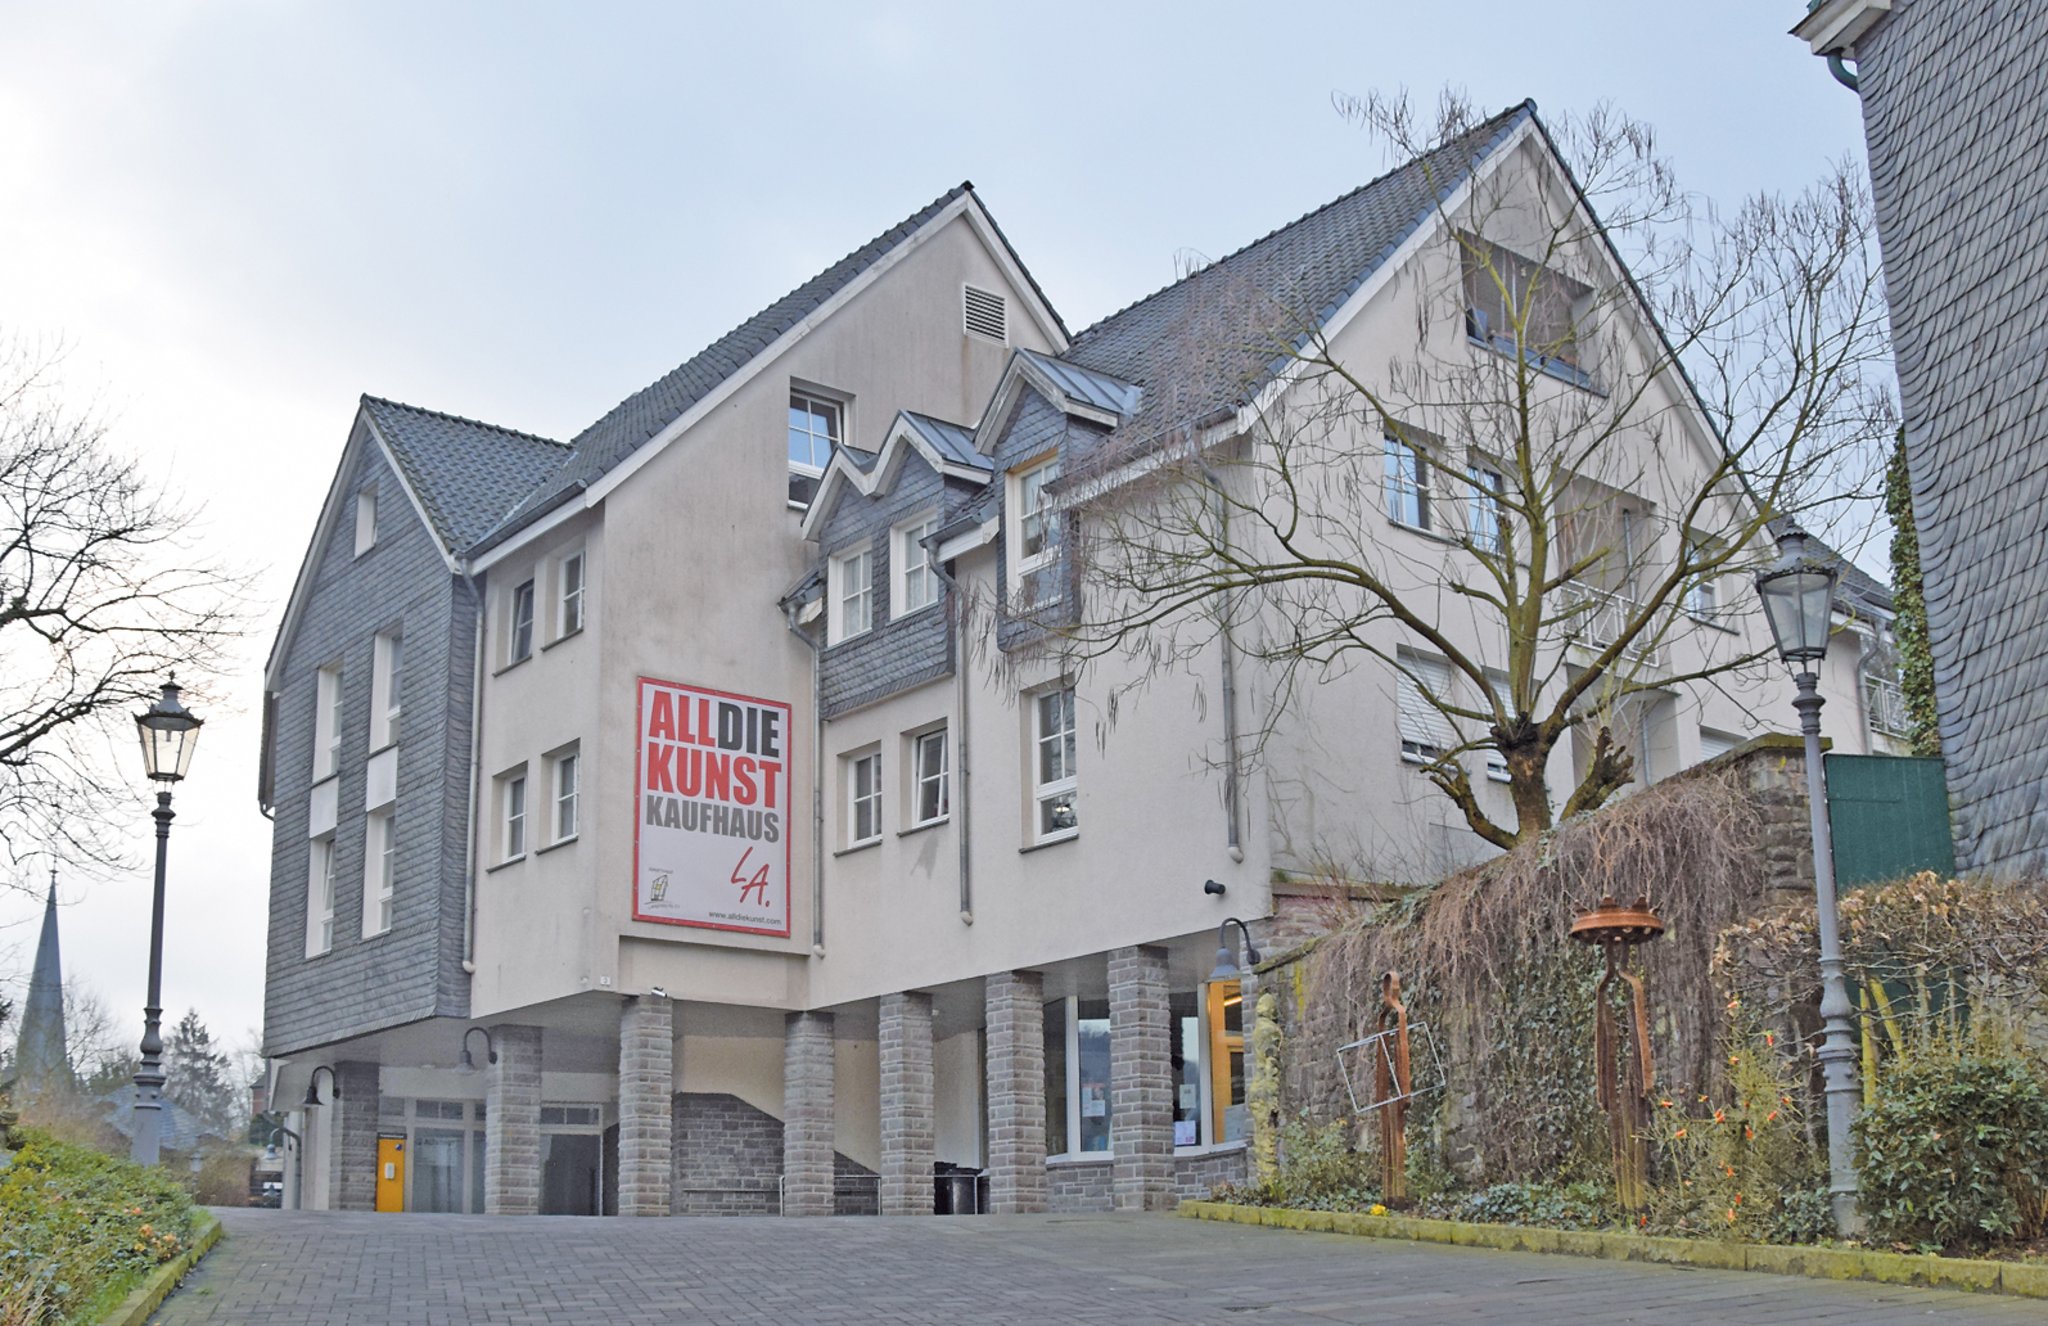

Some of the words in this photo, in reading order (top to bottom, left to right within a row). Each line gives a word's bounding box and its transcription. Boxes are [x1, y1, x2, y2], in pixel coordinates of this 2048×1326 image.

[647, 742, 782, 809] KUNST
[646, 795, 779, 843] KAUFHAUS
[708, 911, 782, 926] www.alldiekunst.com
